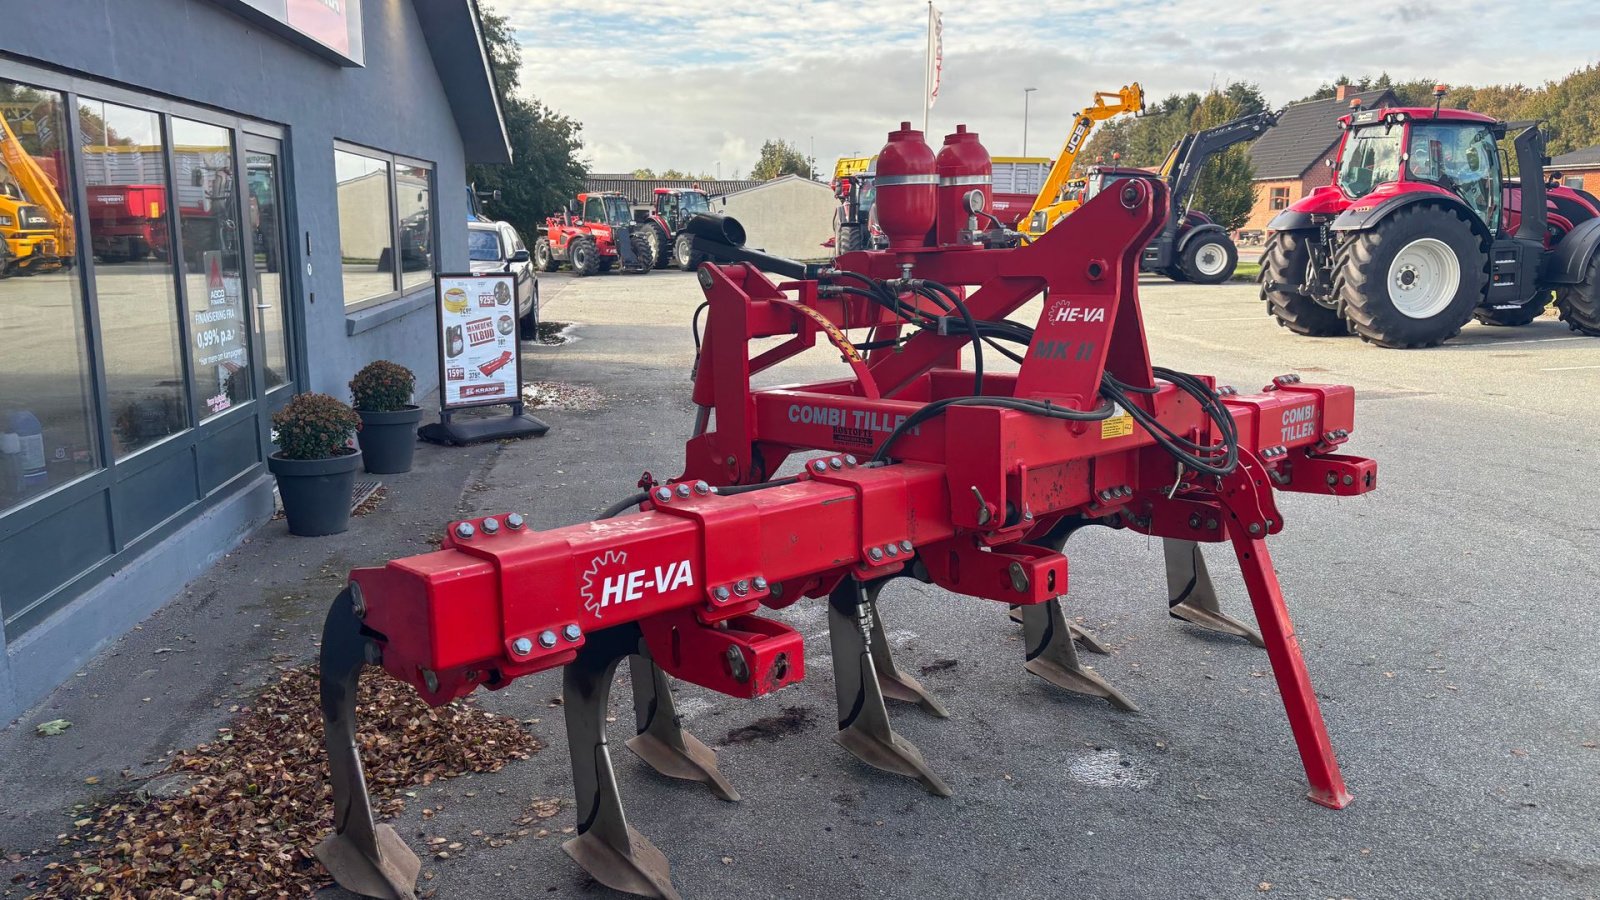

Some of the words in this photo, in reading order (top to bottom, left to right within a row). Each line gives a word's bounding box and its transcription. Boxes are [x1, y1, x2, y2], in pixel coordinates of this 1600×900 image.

[1067, 123, 1086, 154] JCB
[1055, 307, 1105, 323] HE-VA
[197, 328, 220, 349] 0,99%
[468, 329, 495, 343] TILBUD
[1033, 341, 1071, 360] MK
[1076, 342, 1095, 362] II
[788, 404, 847, 428] COMBI
[1282, 405, 1315, 426] COMBI
[1281, 421, 1315, 442] TILLER
[600, 559, 694, 608] HE-VA
